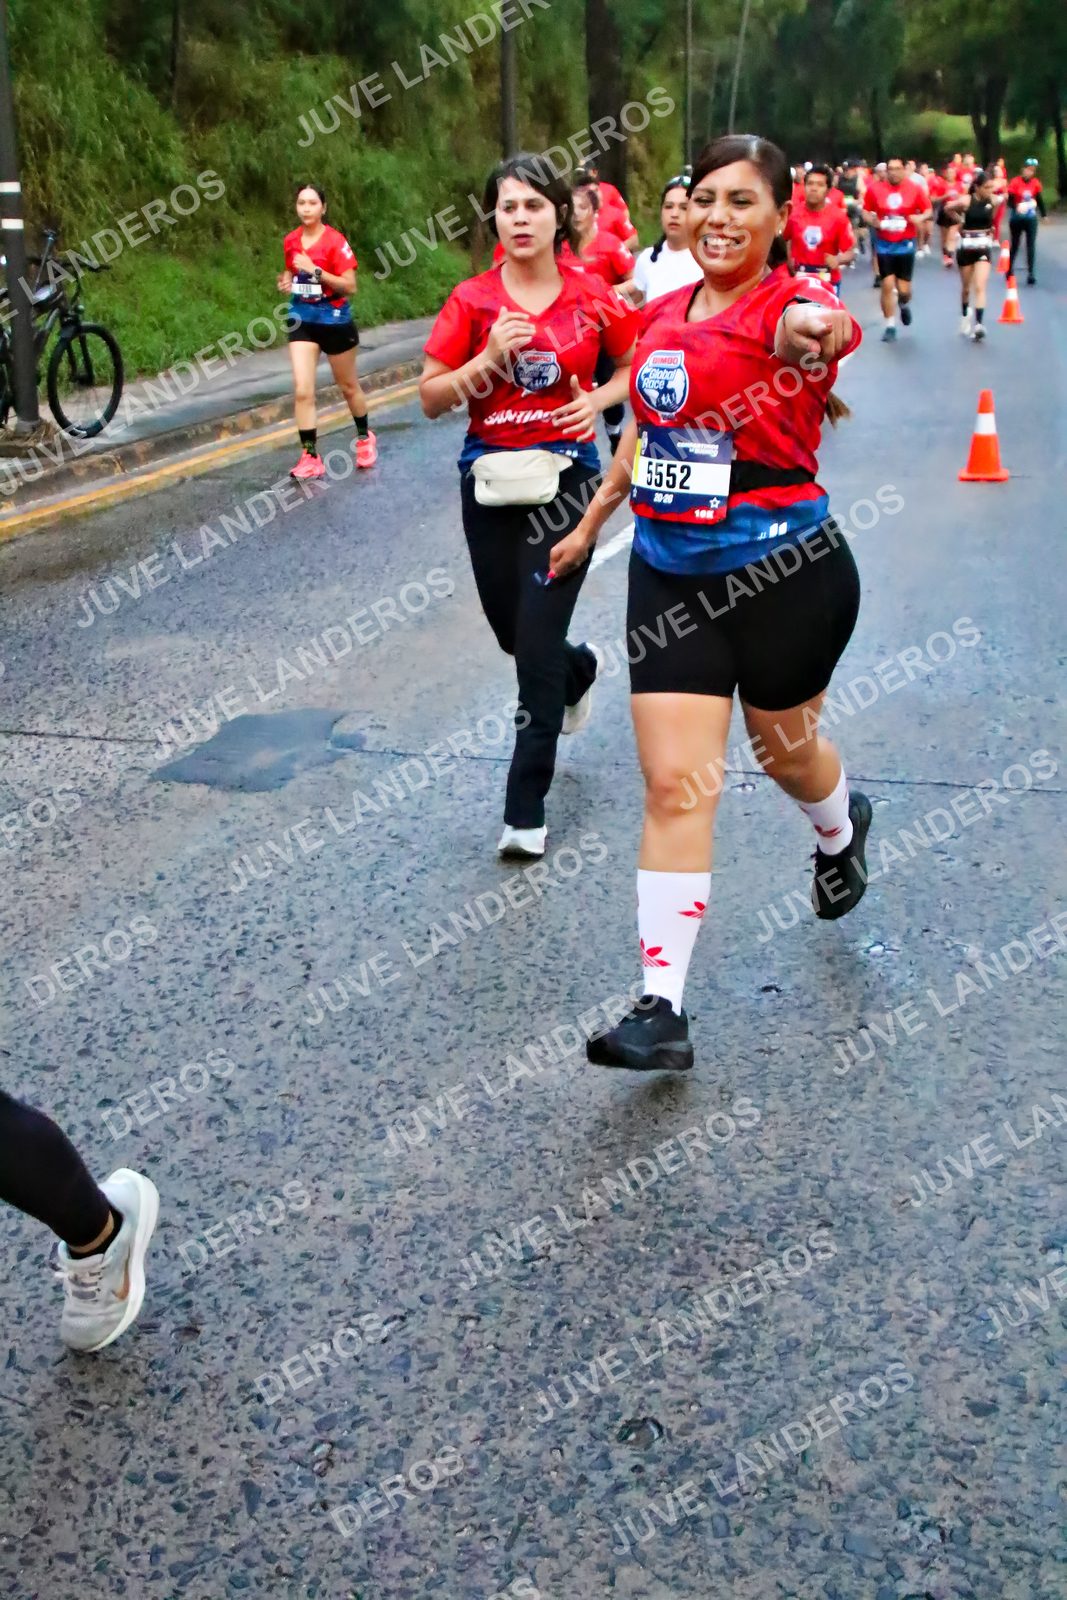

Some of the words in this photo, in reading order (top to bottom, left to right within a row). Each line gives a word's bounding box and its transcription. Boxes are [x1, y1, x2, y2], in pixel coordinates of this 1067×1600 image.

[649, 367, 677, 380] Global
[641, 377, 665, 390] Race
[646, 460, 692, 490] 5552
